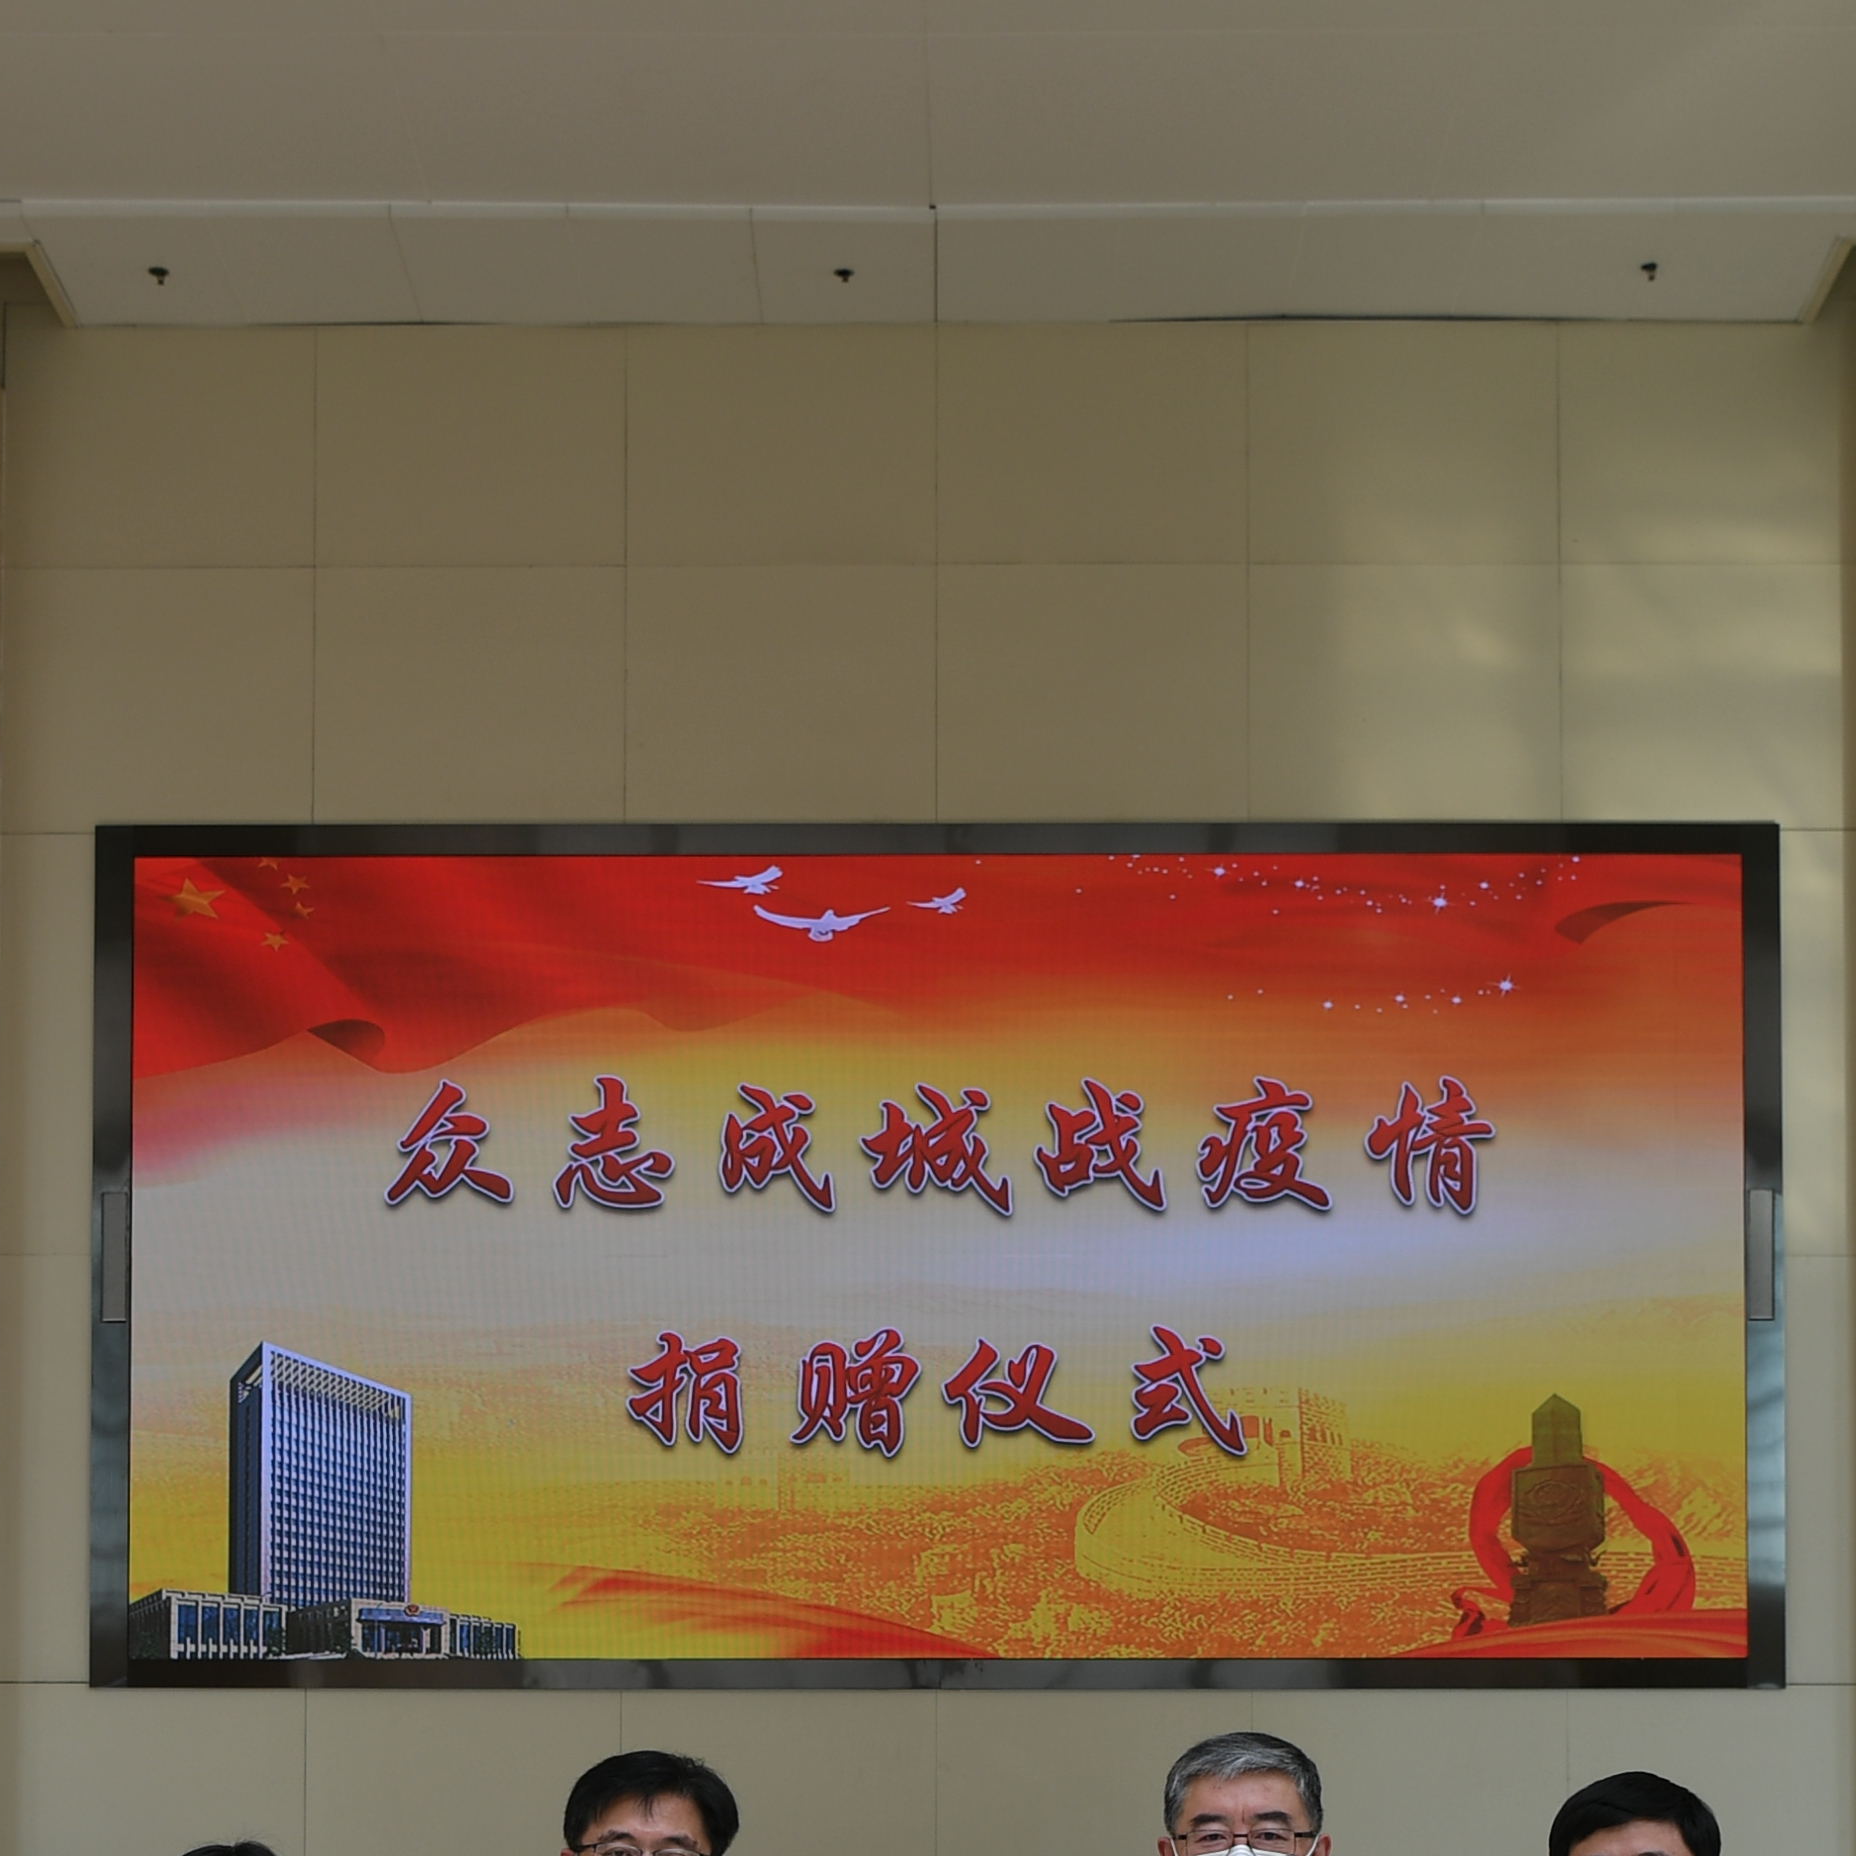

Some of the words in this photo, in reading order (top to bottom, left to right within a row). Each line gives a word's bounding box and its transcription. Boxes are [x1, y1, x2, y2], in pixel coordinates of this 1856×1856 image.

[384, 1076, 1493, 1213] 众志成城战疫情
[629, 1326, 1247, 1456] 捐赠仪式
